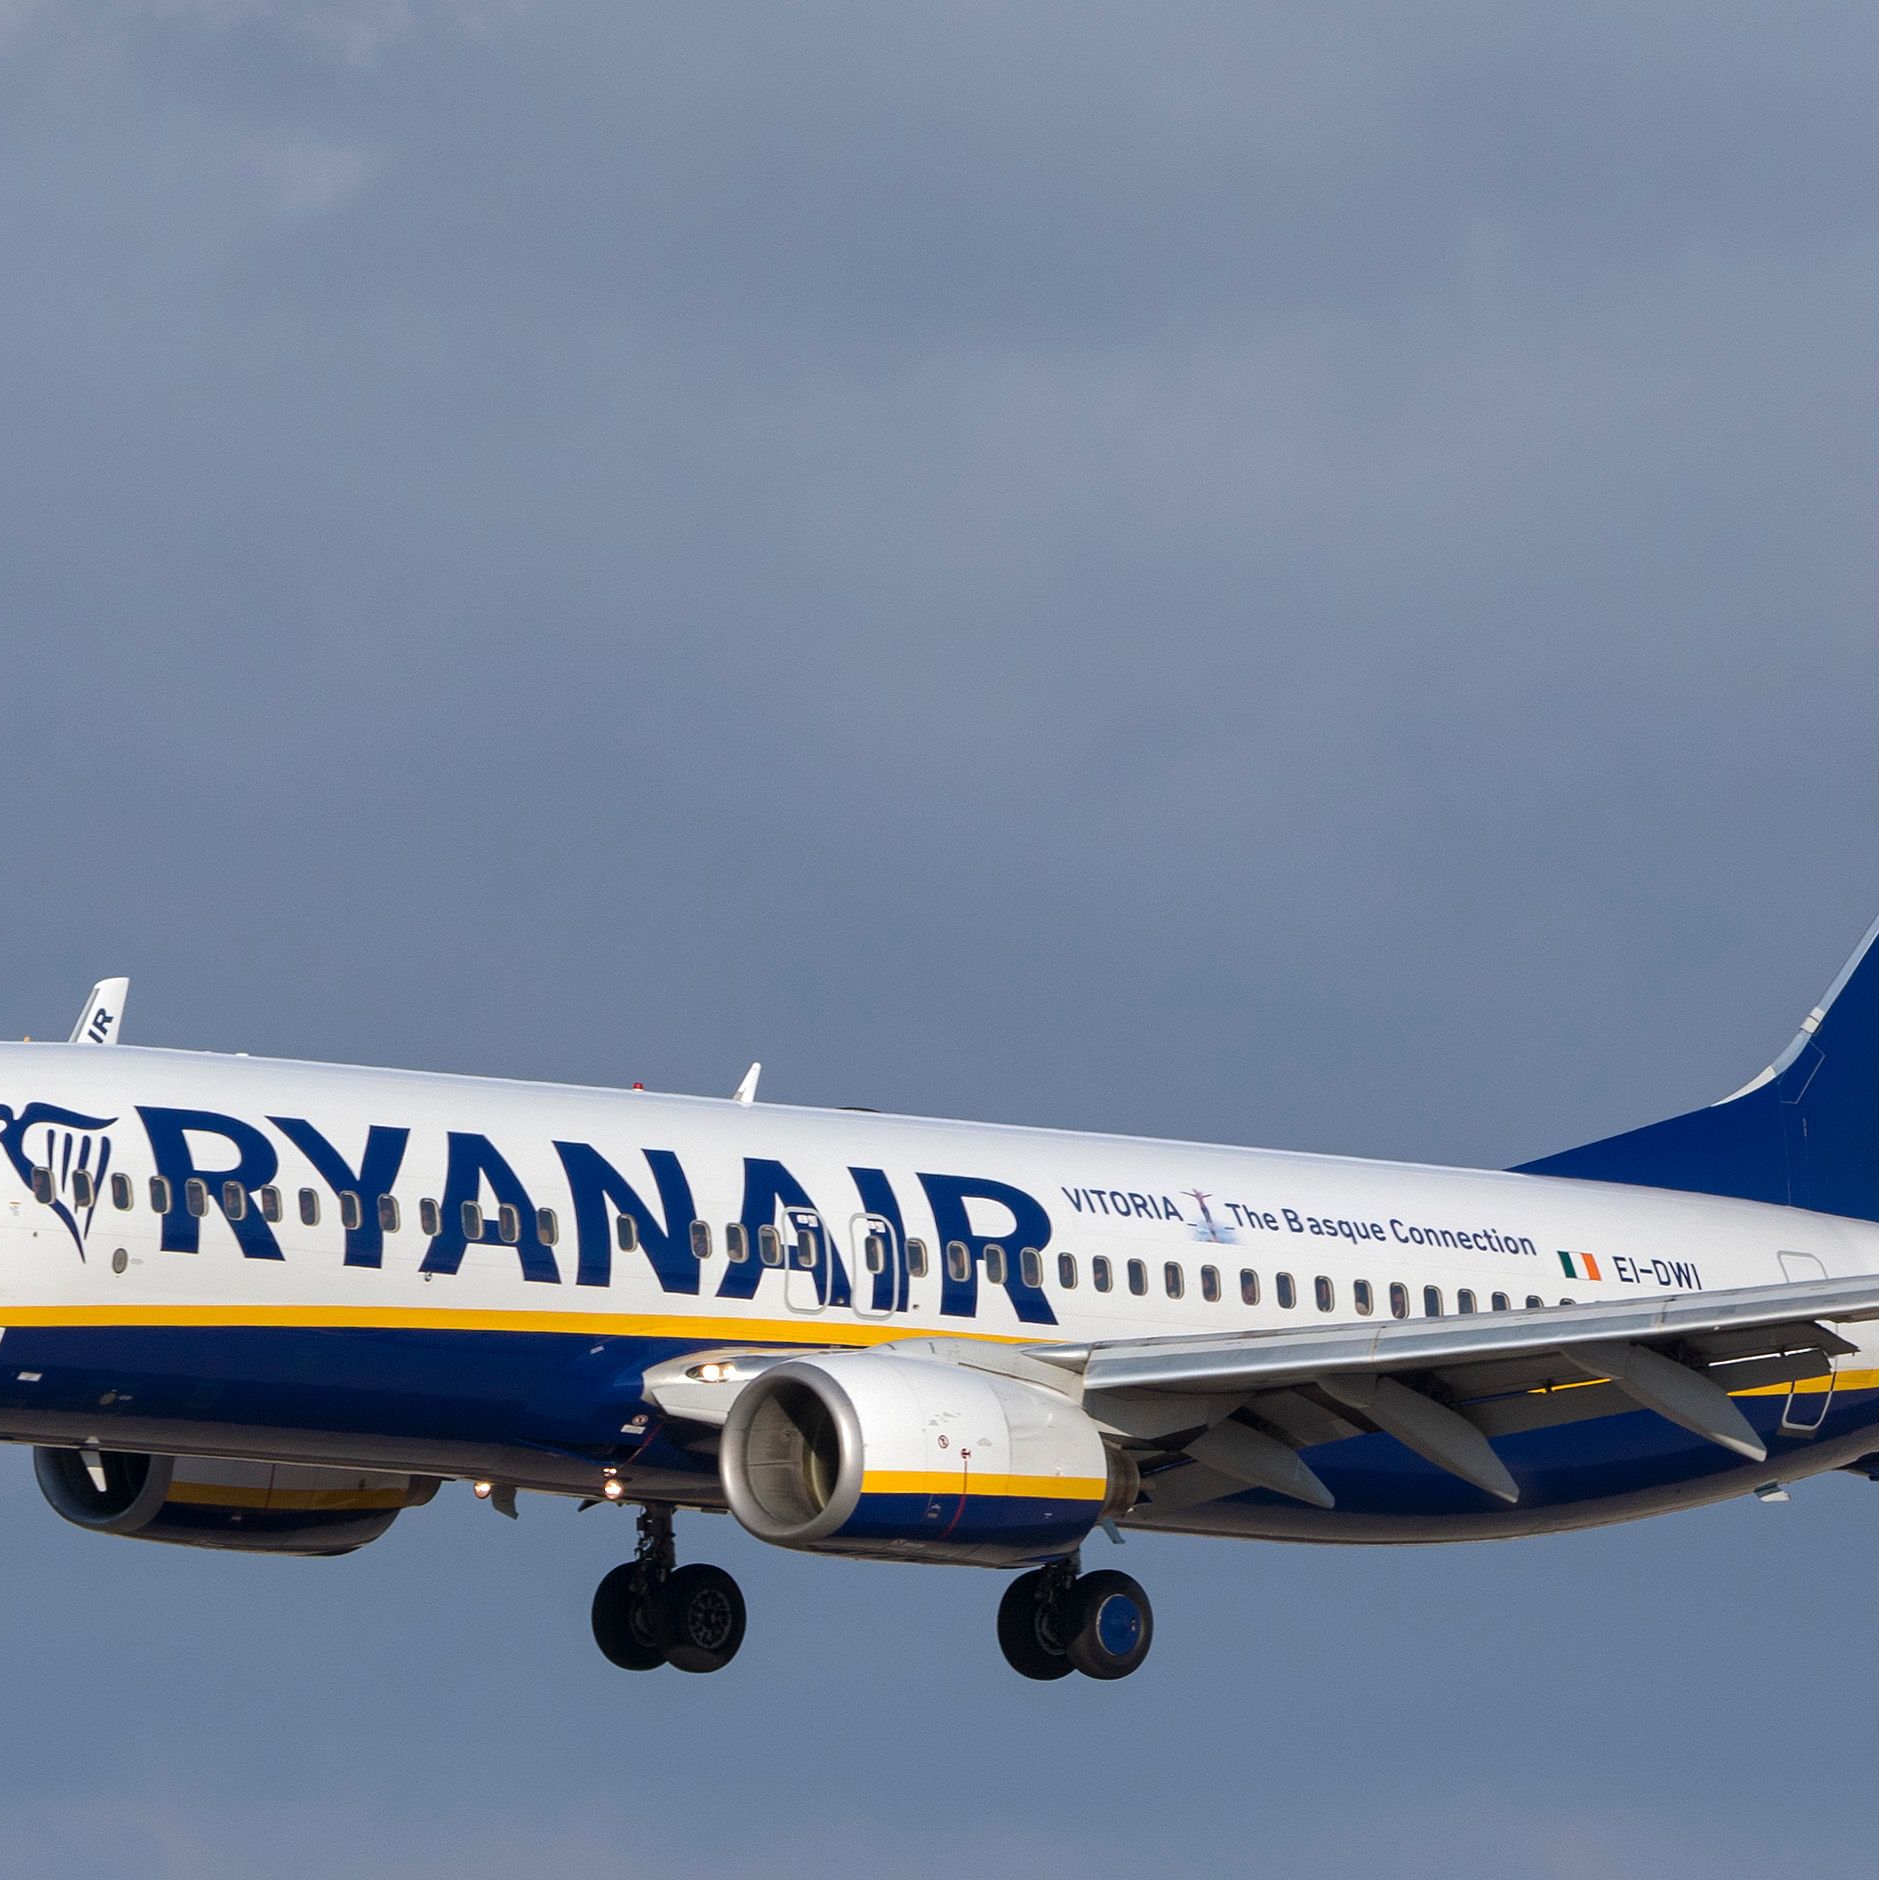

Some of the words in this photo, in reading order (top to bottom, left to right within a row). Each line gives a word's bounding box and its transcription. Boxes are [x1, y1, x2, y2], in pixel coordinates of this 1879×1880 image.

[135, 1105, 1059, 1326] RYANAIR
[1061, 1186, 1184, 1222] VITORIA
[1224, 1202, 1279, 1231] The
[1281, 1207, 1386, 1244] Basque
[1389, 1218, 1537, 1256] Connection
[1612, 1256, 1702, 1290] EI-DWI
